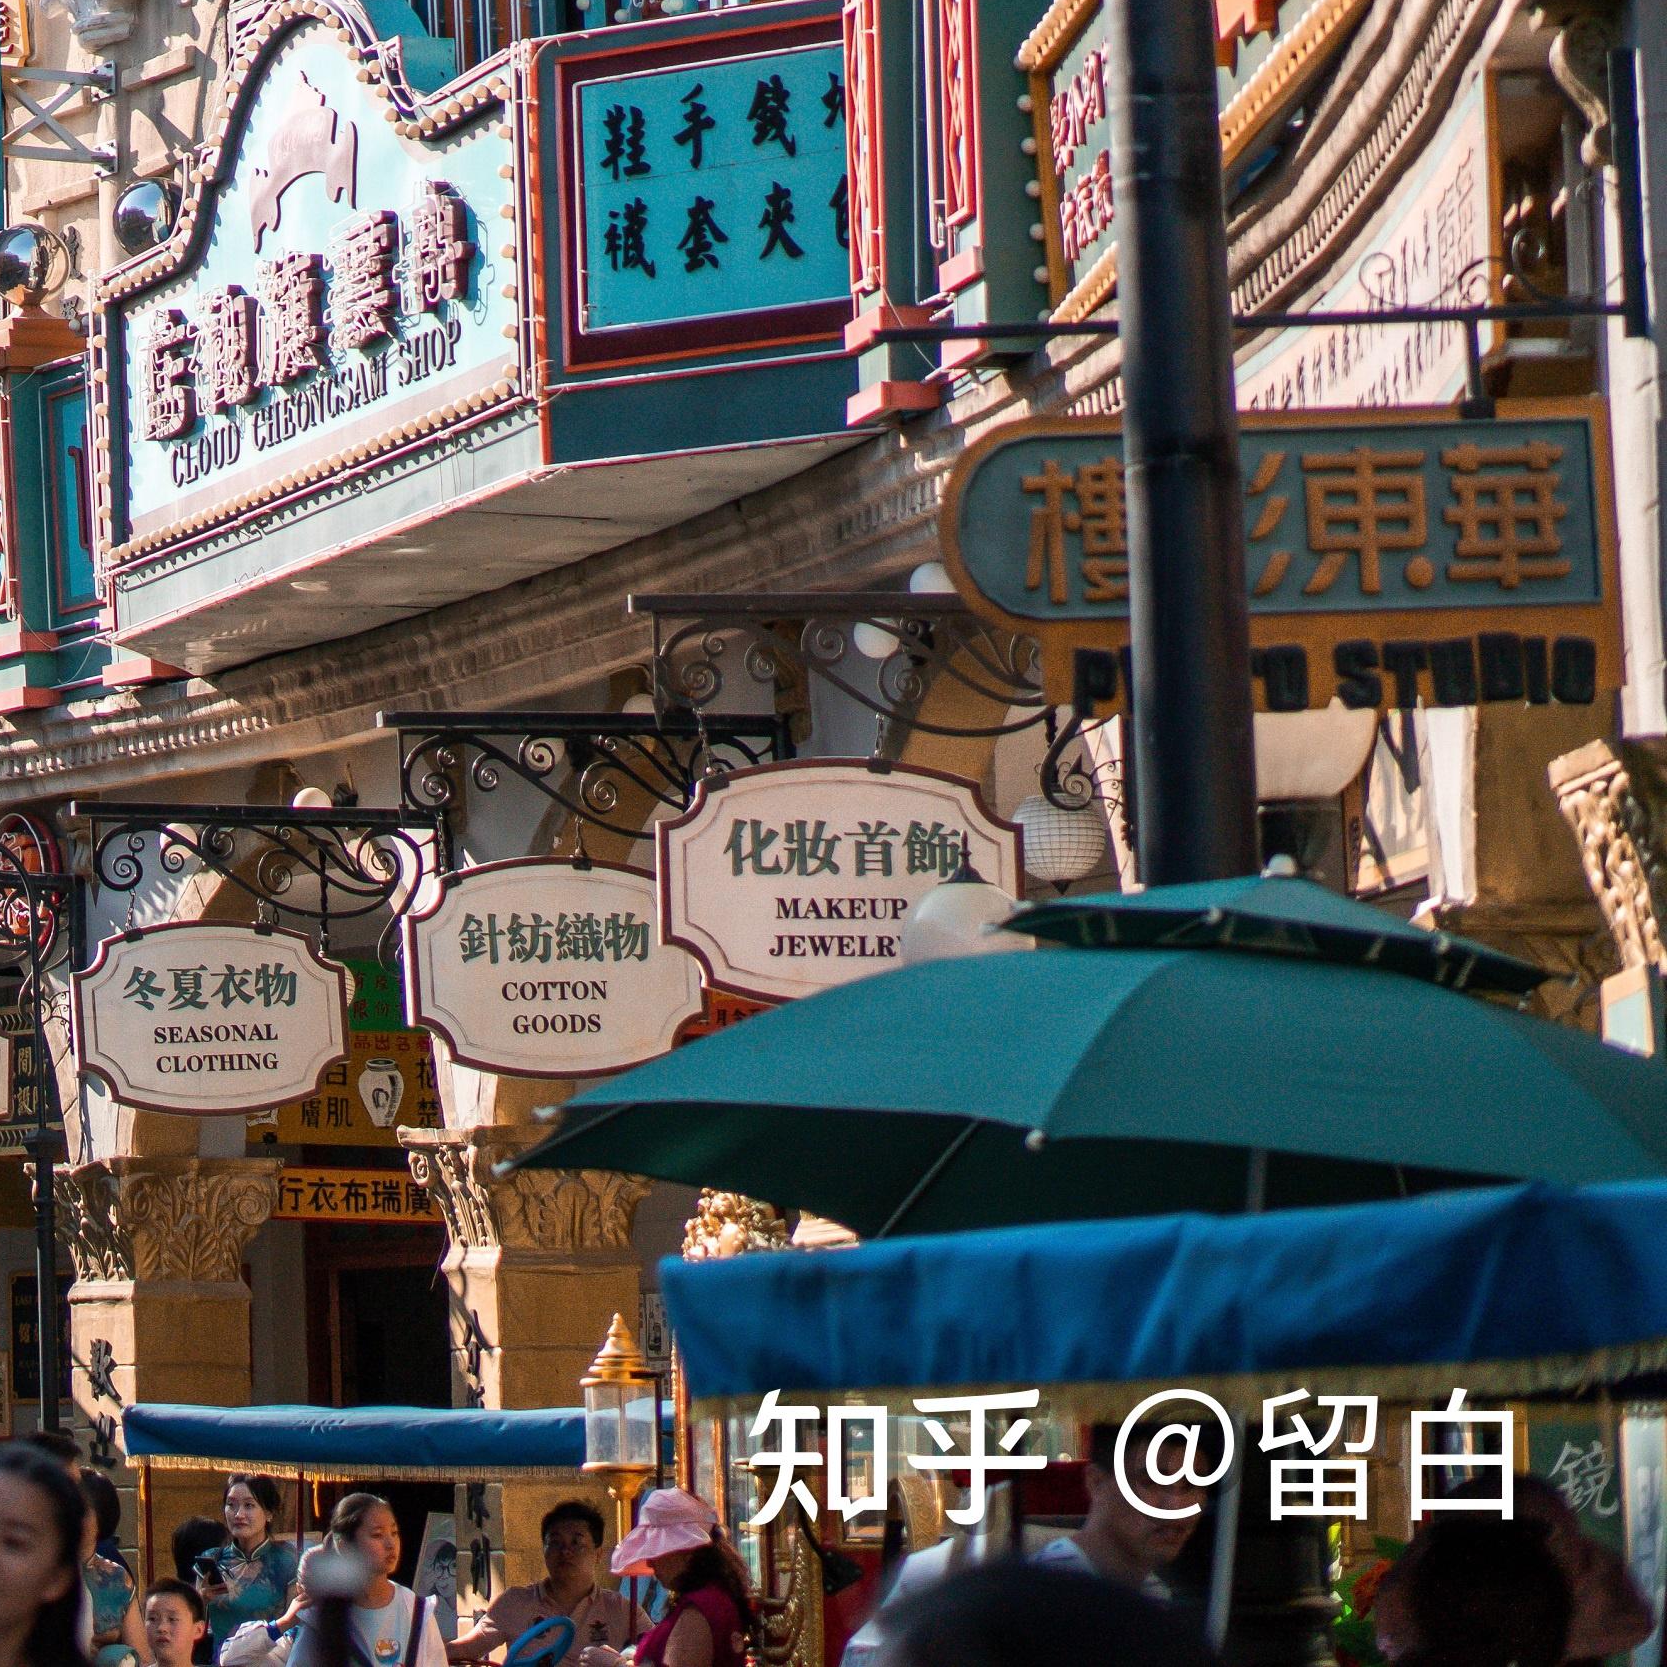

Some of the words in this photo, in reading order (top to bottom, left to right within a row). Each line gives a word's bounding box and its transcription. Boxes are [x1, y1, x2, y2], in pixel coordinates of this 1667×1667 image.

[170, 420, 241, 487] CLOUD
[252, 352, 390, 451] CHEONGSAM
[397, 319, 462, 387] SHOP
[1335, 632, 1597, 709] STUDIO
[775, 896, 909, 921] MAKEUP
[458, 911, 650, 965] 針紡織物
[769, 935, 901, 959] JEWELR
[123, 963, 298, 1011] 冬夏衣物
[501, 979, 608, 1003] COTTON
[153, 1024, 279, 1047] SEASONAL
[513, 1013, 602, 1036] GOODS
[155, 1053, 279, 1075] CLOTHING
